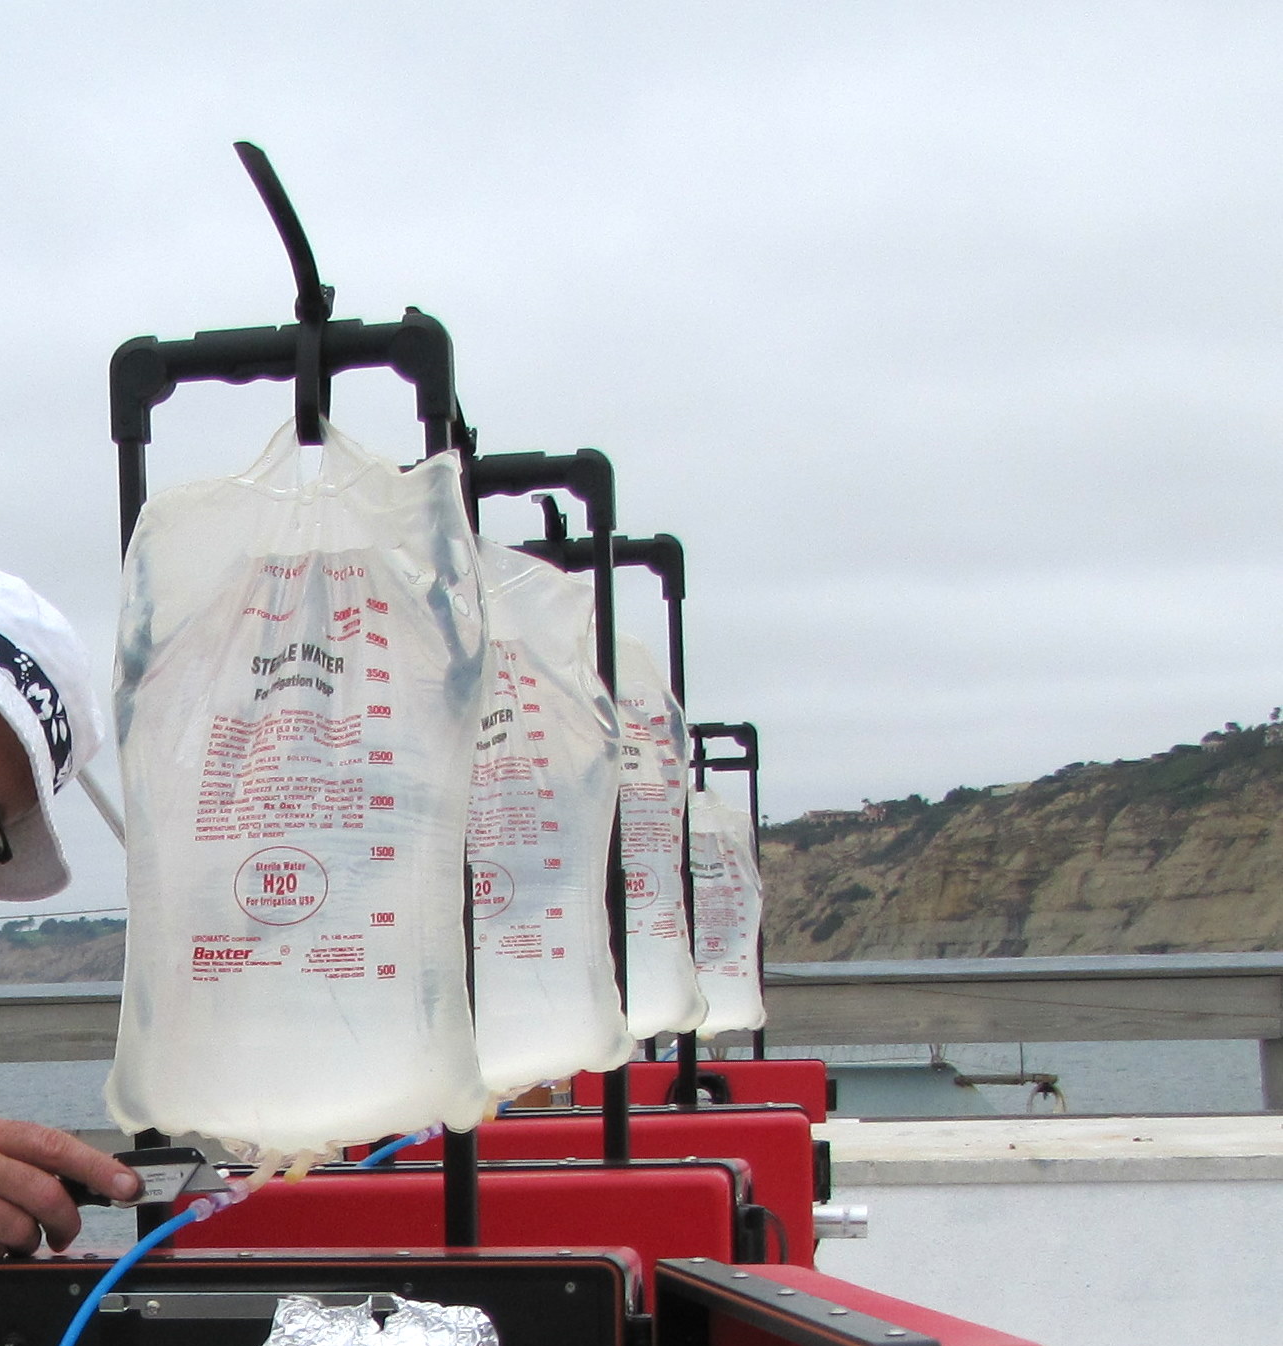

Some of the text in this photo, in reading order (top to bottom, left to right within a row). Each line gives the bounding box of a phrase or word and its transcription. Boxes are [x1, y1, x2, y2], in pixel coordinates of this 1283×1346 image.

[301, 643, 344, 674] WATER
[366, 668, 390, 680] 3500
[316, 677, 334, 697] USP
[367, 705, 391, 715] 3000
[481, 709, 513, 731] WATER
[368, 751, 393, 762] 2500
[369, 796, 394, 807] 2000
[370, 847, 394, 857] 1500
[255, 862, 306, 871] Sterile Water
[263, 873, 297, 895] H2O
[475, 880, 491, 897] 2O
[246, 896, 315, 907] For Irrigation USP
[370, 912, 394, 923] 1000
[193, 947, 253, 960] Baxter
[377, 965, 395, 975] 500
